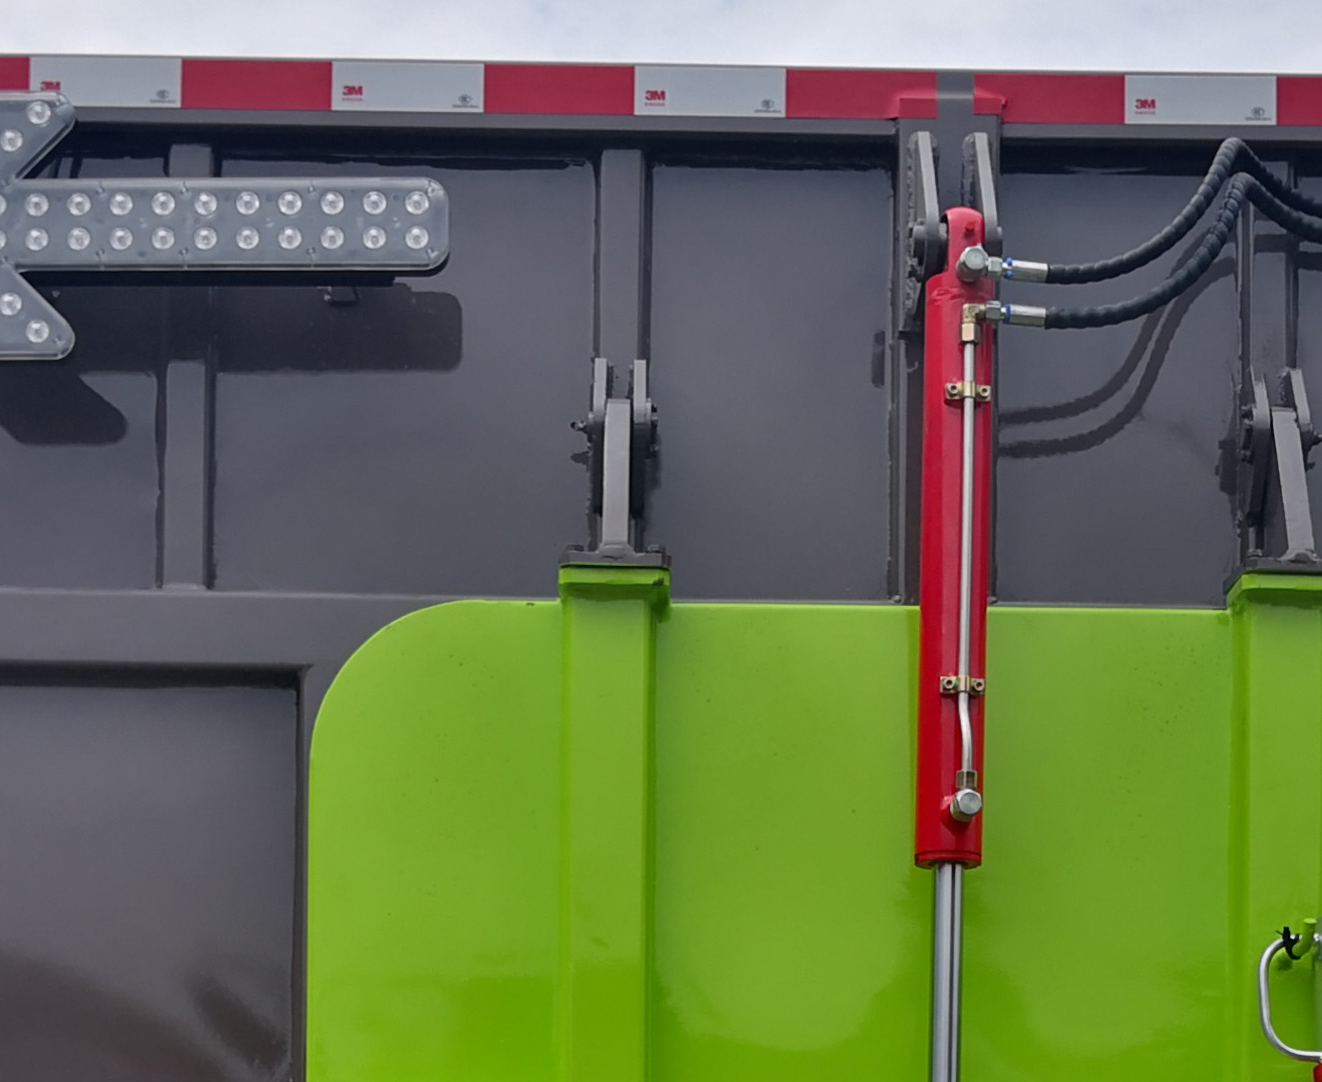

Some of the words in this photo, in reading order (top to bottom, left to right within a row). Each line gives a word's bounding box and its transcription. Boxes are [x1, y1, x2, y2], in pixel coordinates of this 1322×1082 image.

[342, 85, 363, 96] 3M
[645, 90, 666, 101] 3M
[1135, 98, 1156, 110] 3M
